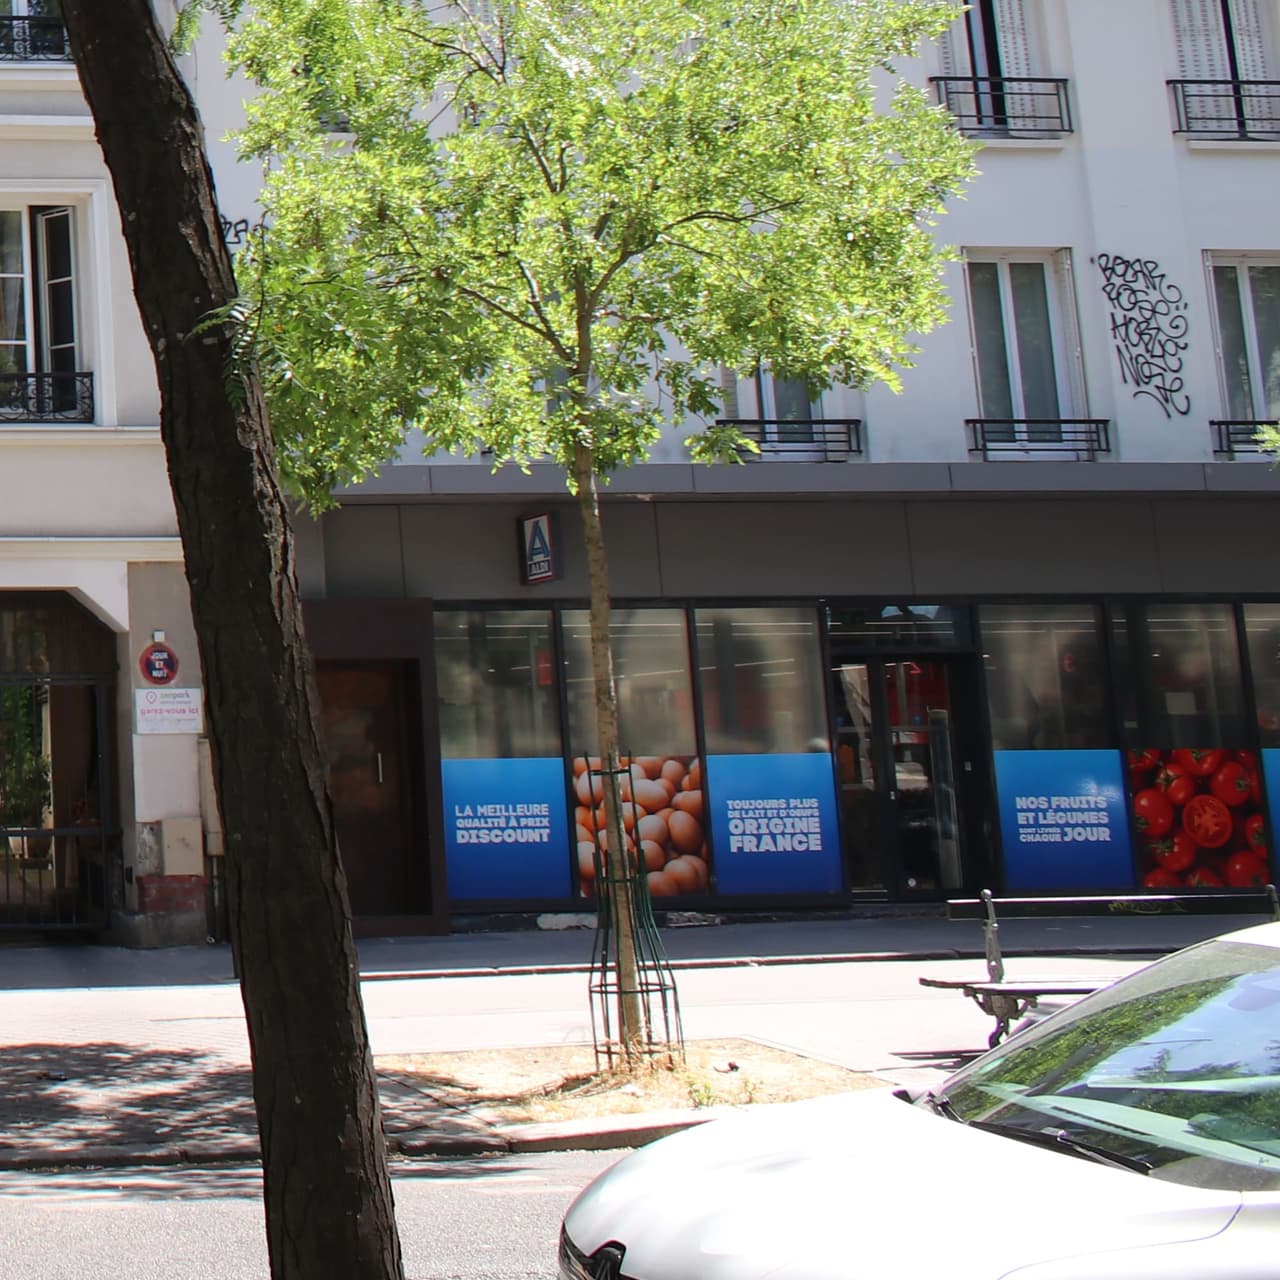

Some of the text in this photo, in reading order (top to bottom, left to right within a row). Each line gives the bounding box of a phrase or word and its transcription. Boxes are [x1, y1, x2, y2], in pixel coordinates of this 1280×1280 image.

[727, 799, 818, 809] TOUJOURS PLUS
[1016, 796, 1107, 809] NOS FRUITS
[455, 804, 549, 816] LA MEILLEURE
[727, 810, 741, 818] DE
[1017, 809, 1109, 824] ET LÉGUMES
[456, 815, 550, 828] QUALITÉ À PRIX
[728, 817, 820, 834] ORIGINE
[456, 829, 550, 843] DISCOUNT
[1020, 827, 1112, 842] CHAQUE JOUR
[729, 834, 822, 852] FRANCE
